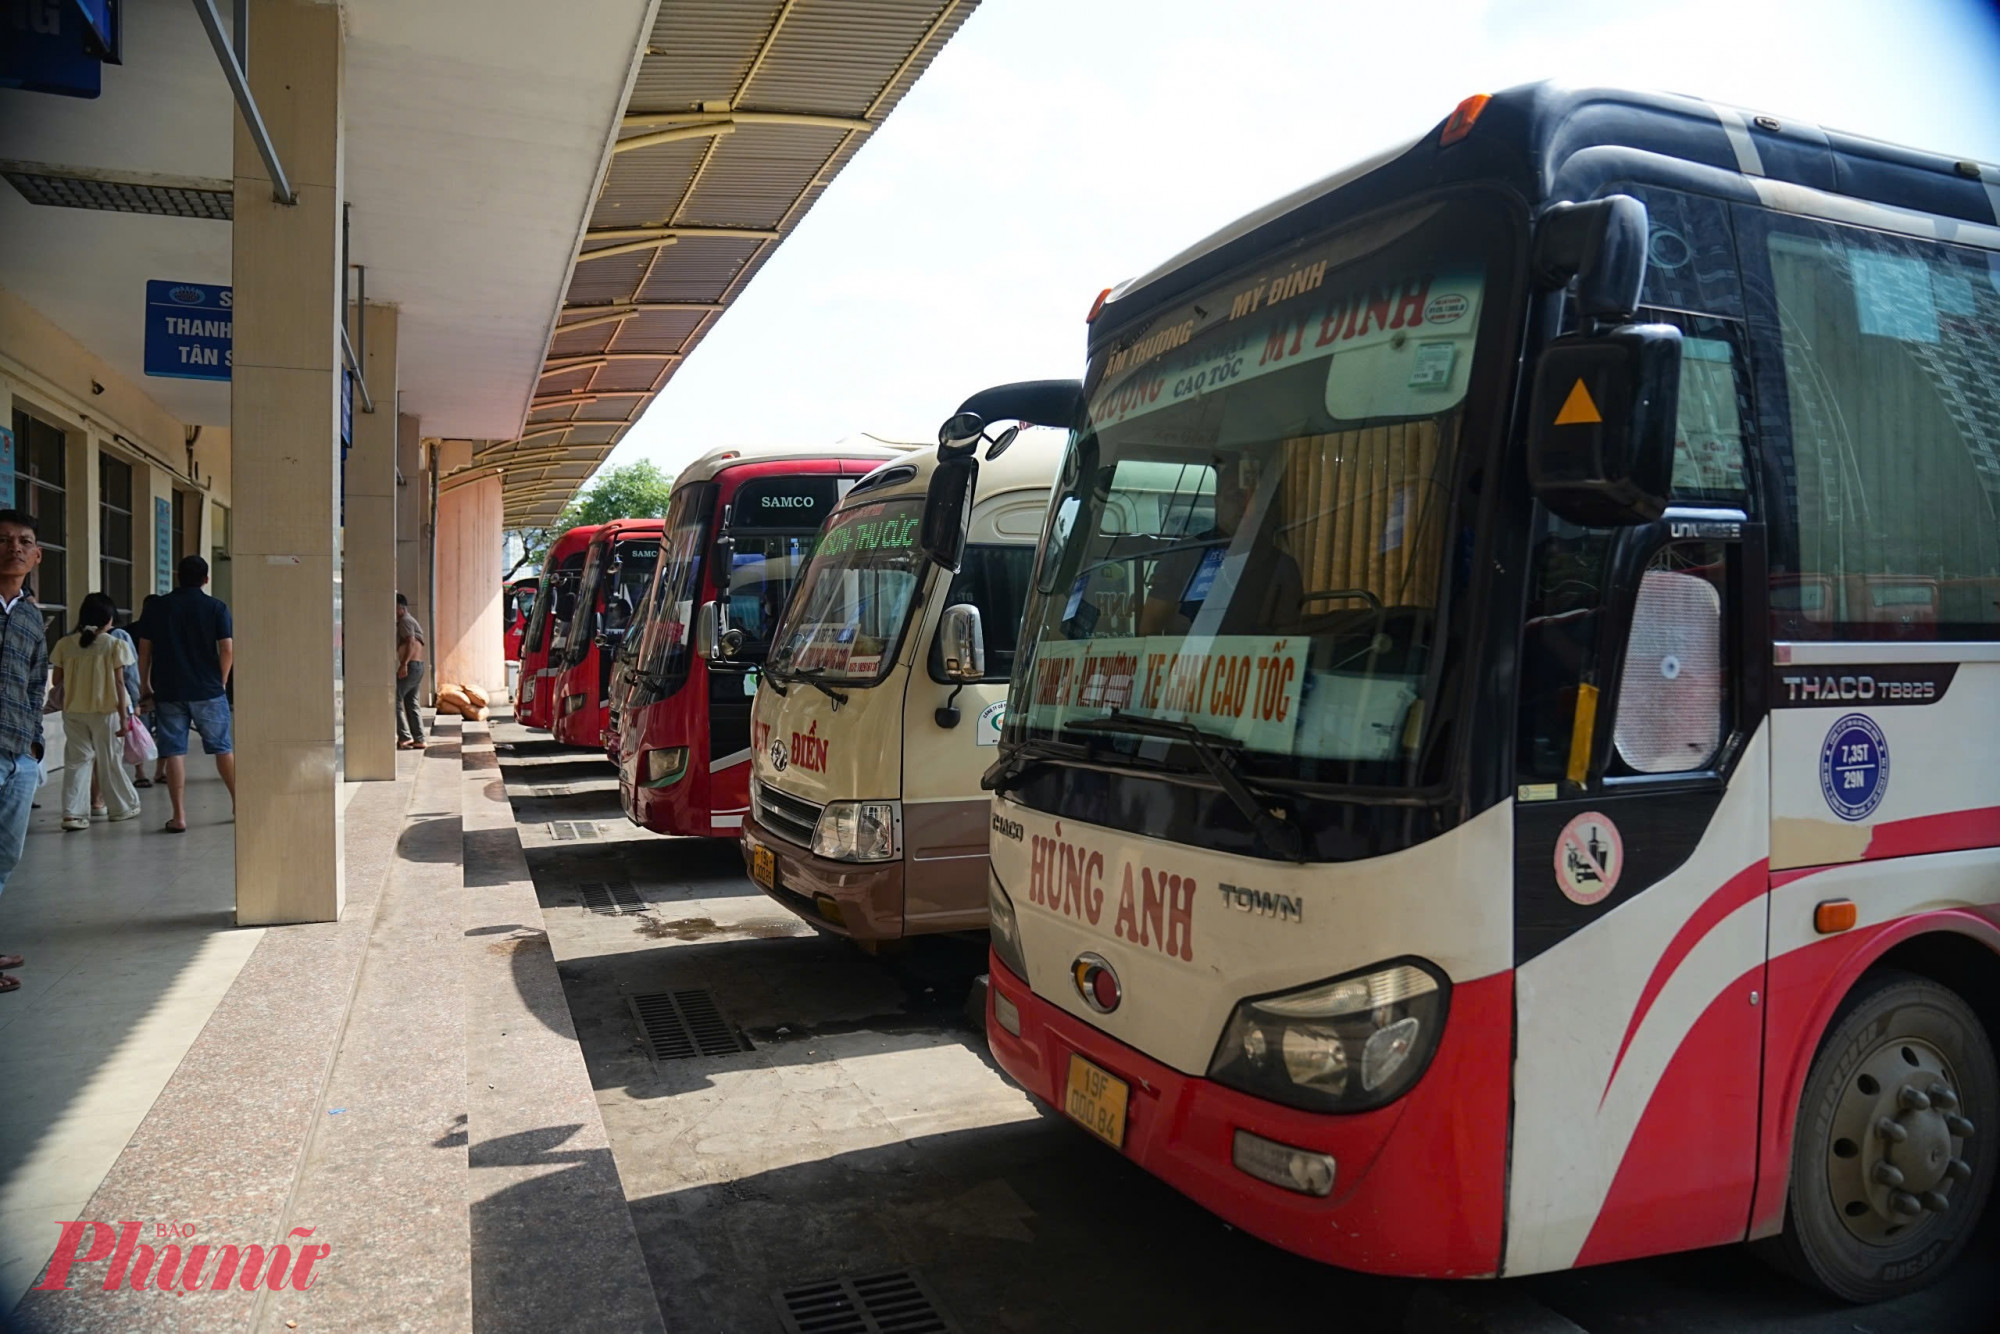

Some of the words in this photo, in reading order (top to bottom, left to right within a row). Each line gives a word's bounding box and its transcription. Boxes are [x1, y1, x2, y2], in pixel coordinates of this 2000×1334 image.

[165, 316, 232, 339] THANH
[178, 343, 219, 366] TÂN
[1174, 371, 1206, 398] CAO
[761, 496, 814, 509] SAMCO
[1670, 522, 1741, 538] UNIVE
[632, 550, 659, 558] SAMC
[1140, 653, 1166, 709] XE
[1163, 653, 1212, 723] CHẠY
[1210, 654, 1251, 718] CAO
[1252, 638, 1296, 724] TỐC
[1782, 675, 1875, 700] THACO
[1841, 743, 1870, 765] 7,35T
[1843, 770, 1865, 789] 29N
[1114, 861, 1197, 963] ANH
[1218, 882, 1304, 925] TOWN
